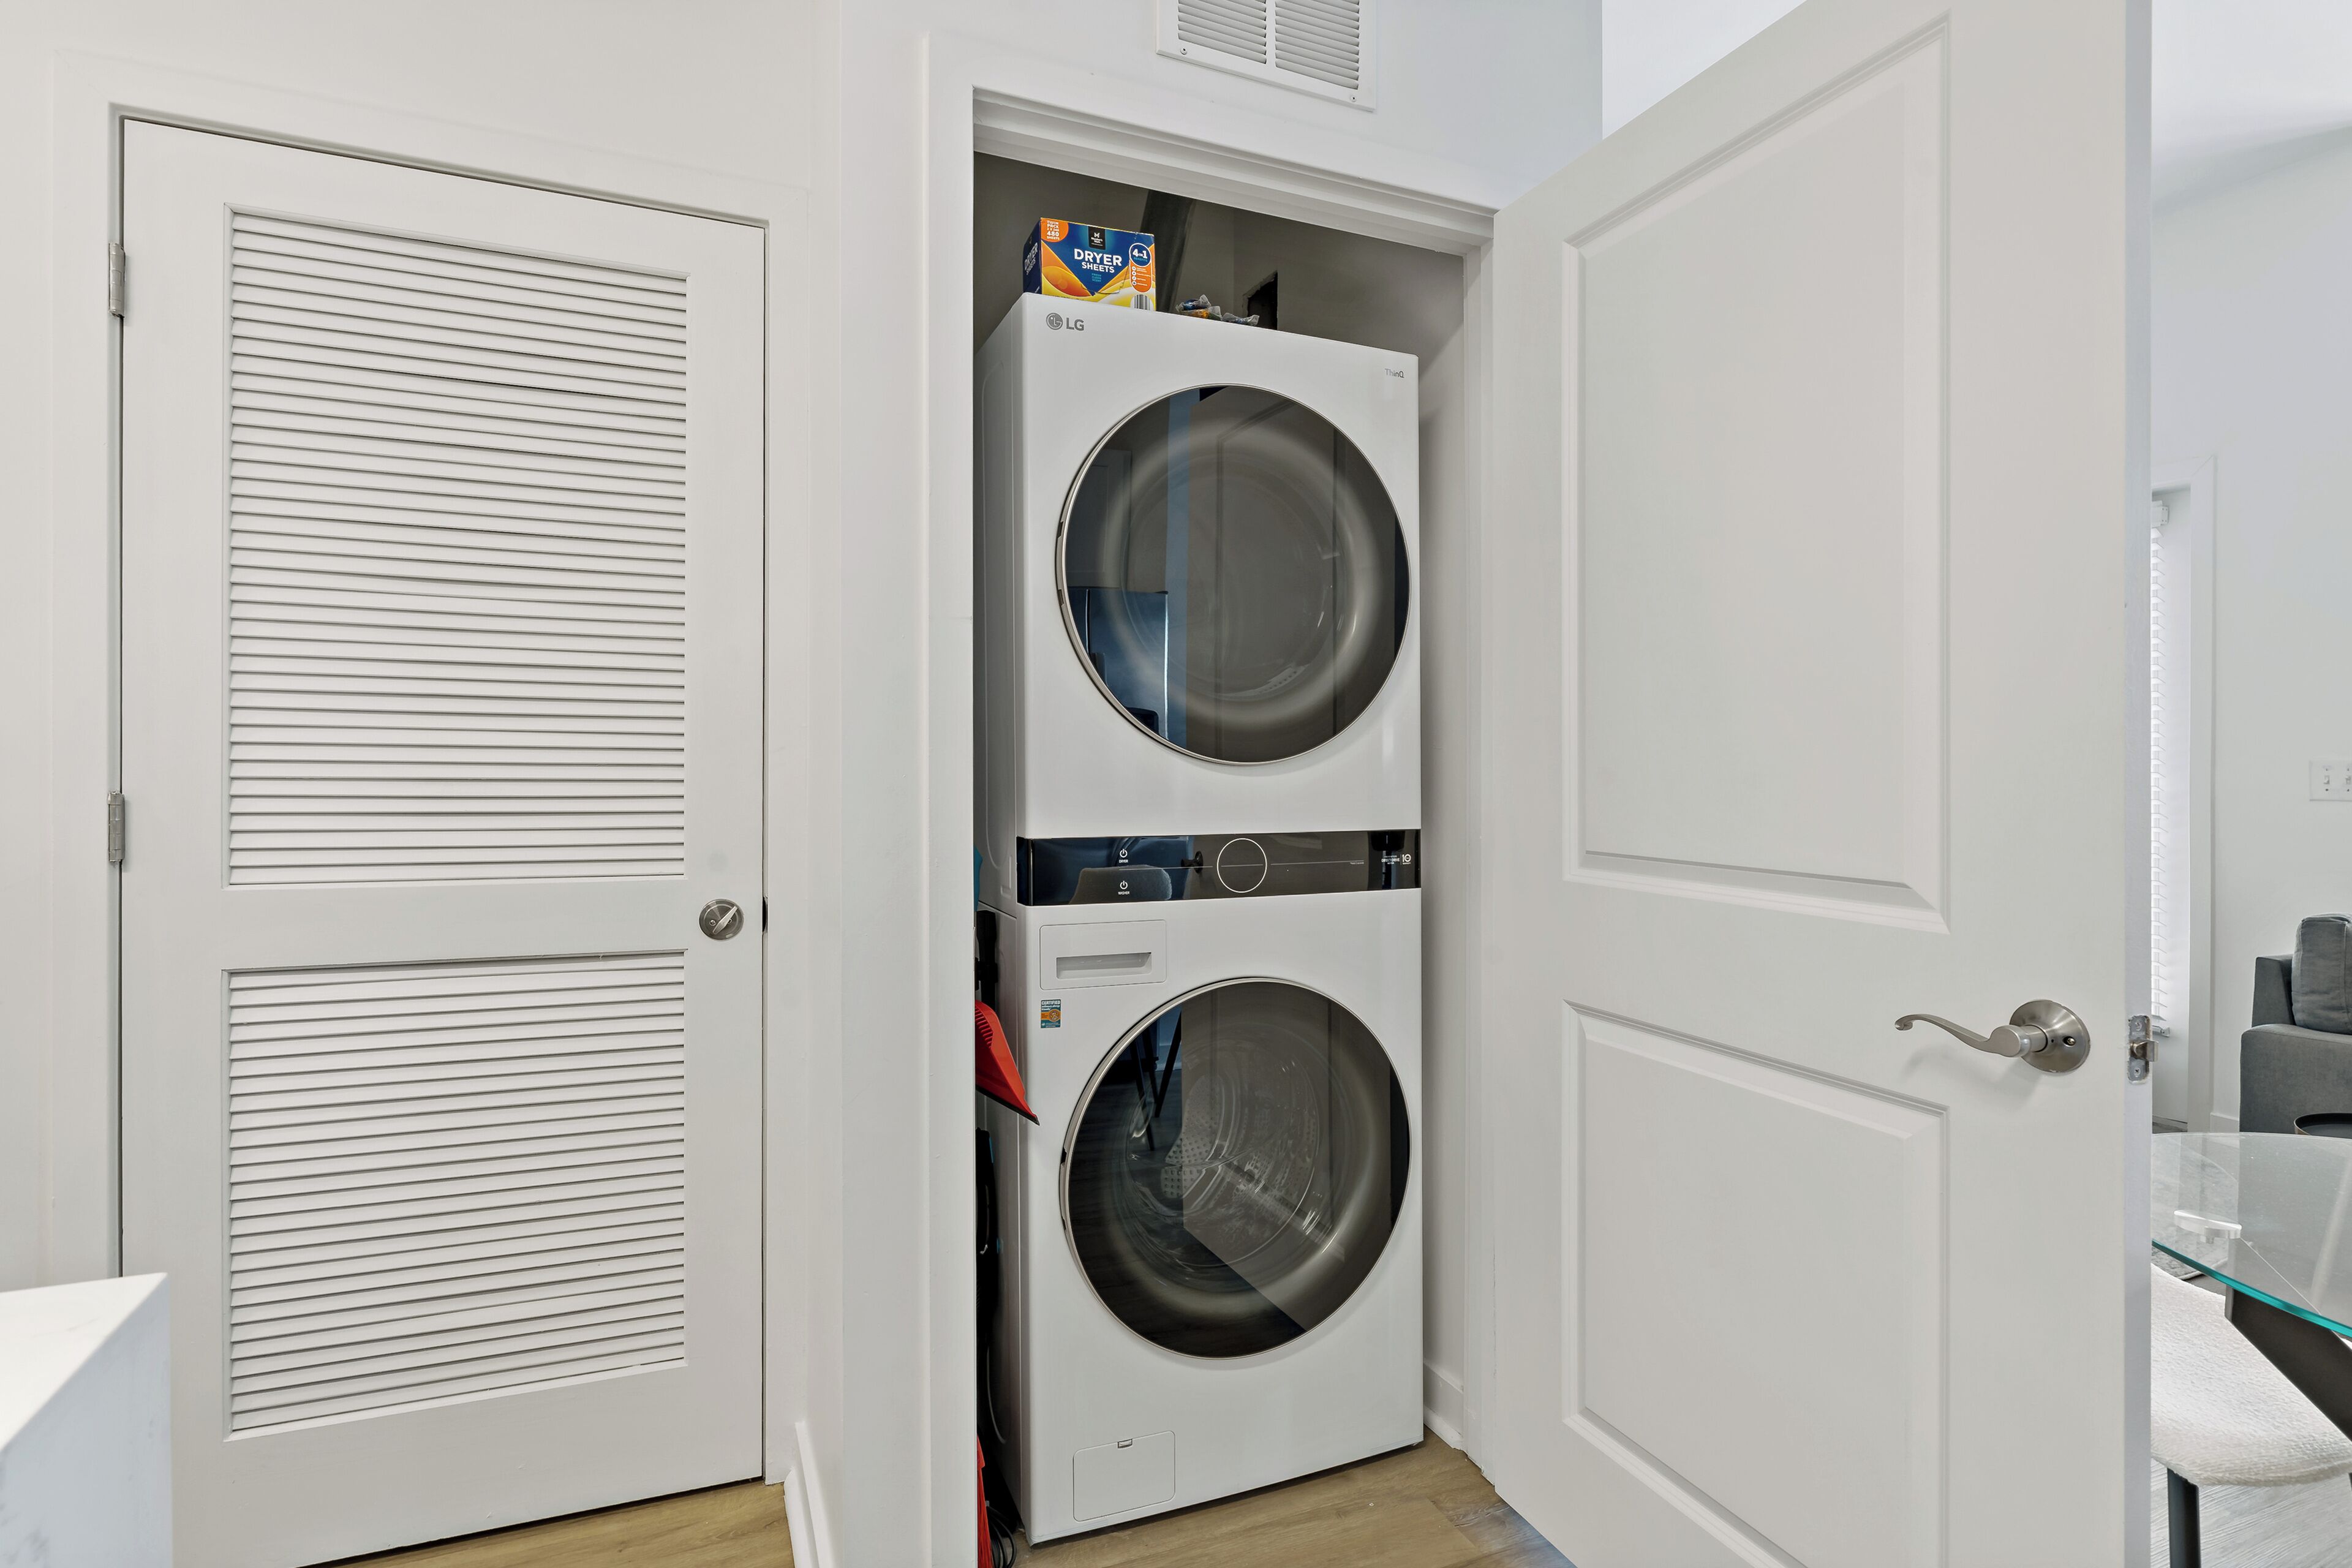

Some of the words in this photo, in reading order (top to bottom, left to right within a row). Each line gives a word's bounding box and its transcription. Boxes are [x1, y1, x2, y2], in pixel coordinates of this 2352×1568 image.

[1074, 248, 1122, 266] DRYER
[1082, 262, 1115, 273] SHEETS
[1066, 317, 1084, 331] LG
[1384, 368, 1404, 378] ThinQ
